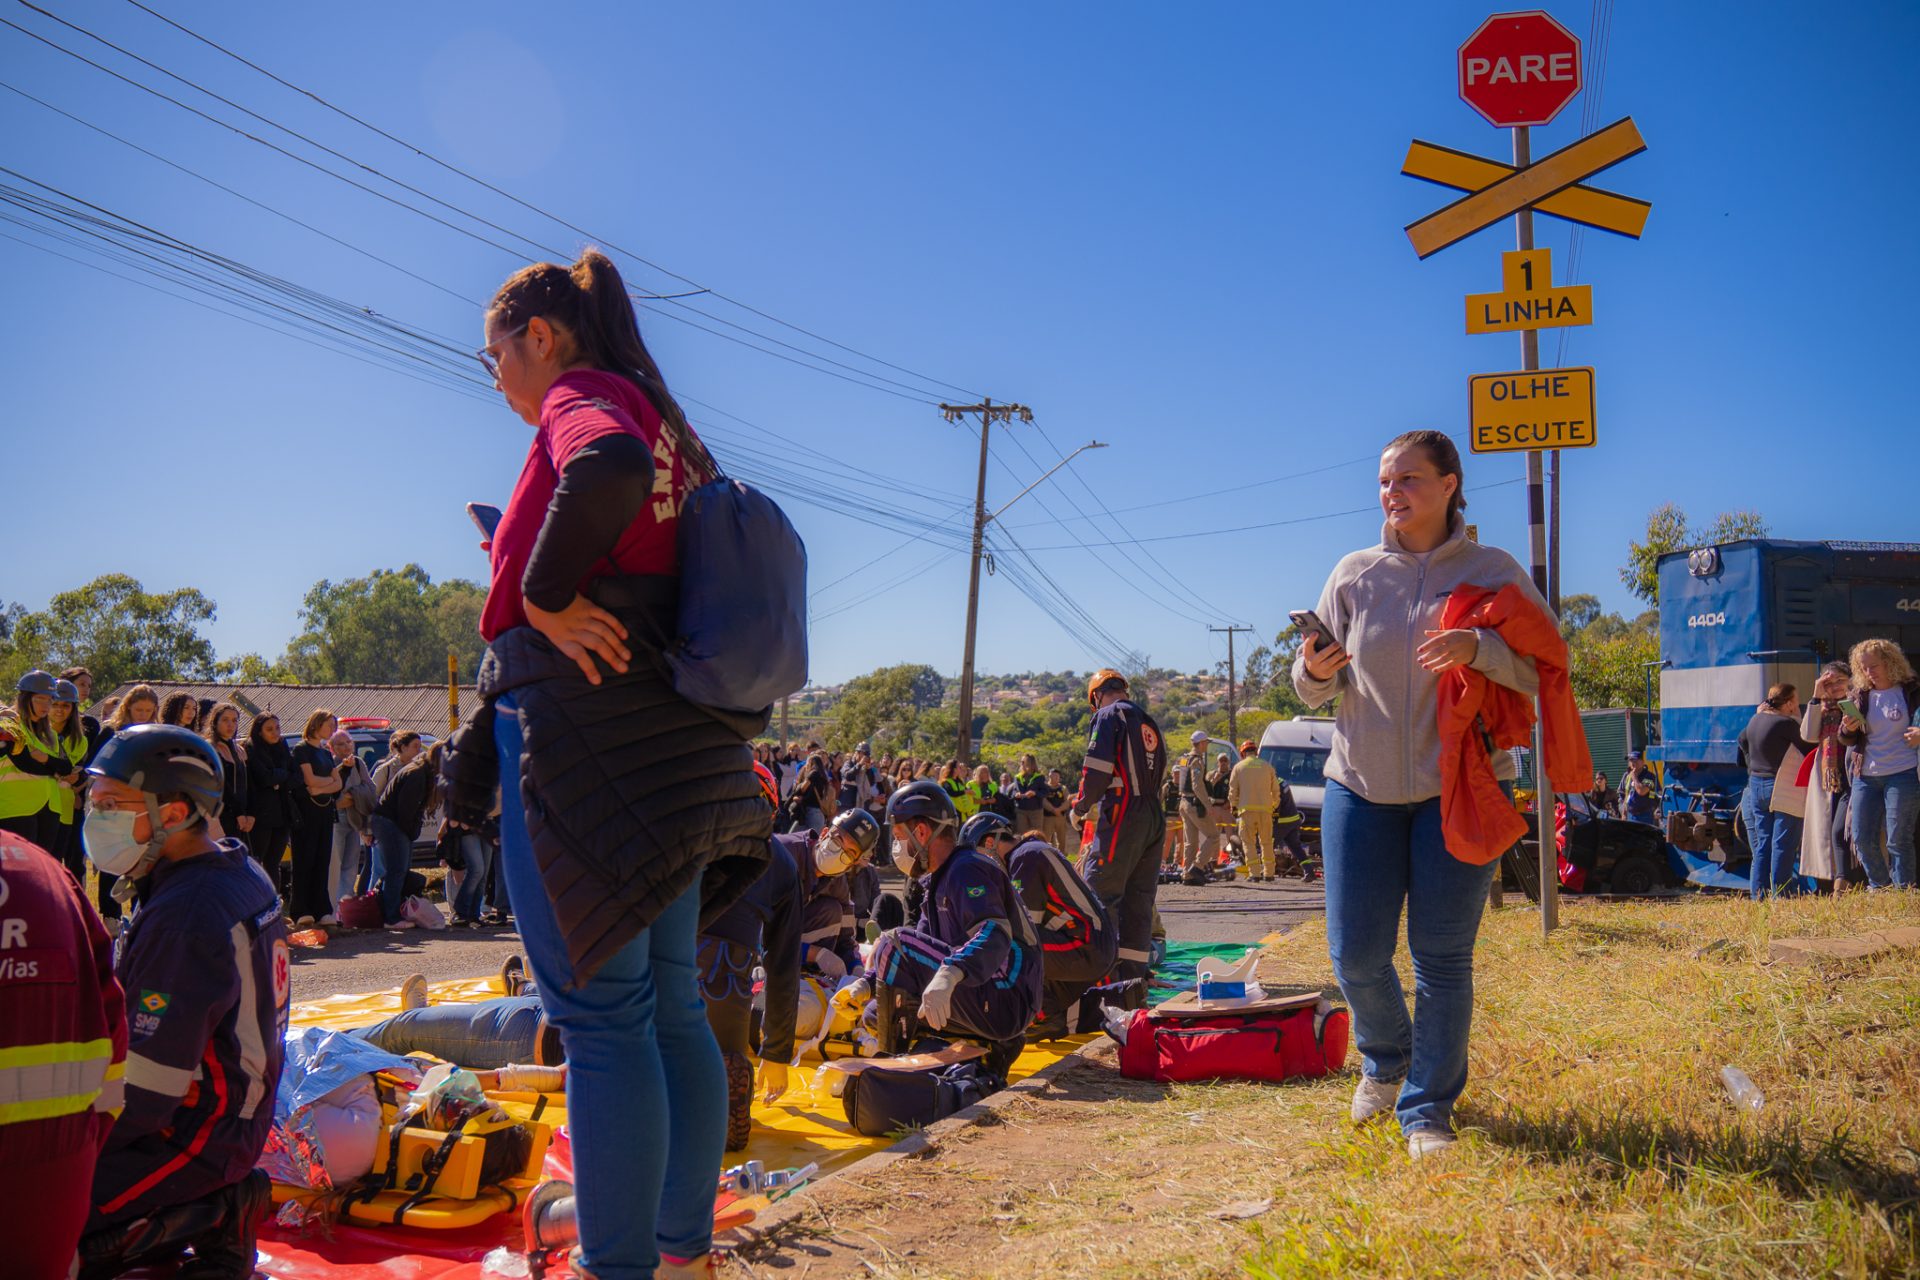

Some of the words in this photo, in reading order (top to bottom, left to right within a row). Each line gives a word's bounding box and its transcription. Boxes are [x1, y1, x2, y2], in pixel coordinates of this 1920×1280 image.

[1467, 52, 1574, 86] PARE
[1520, 260, 1533, 291] 1
[1484, 296, 1577, 325] LINHA
[1490, 376, 1570, 402] OLHE
[1478, 420, 1585, 445] ESCUTE
[1687, 612, 1726, 628] 4404
